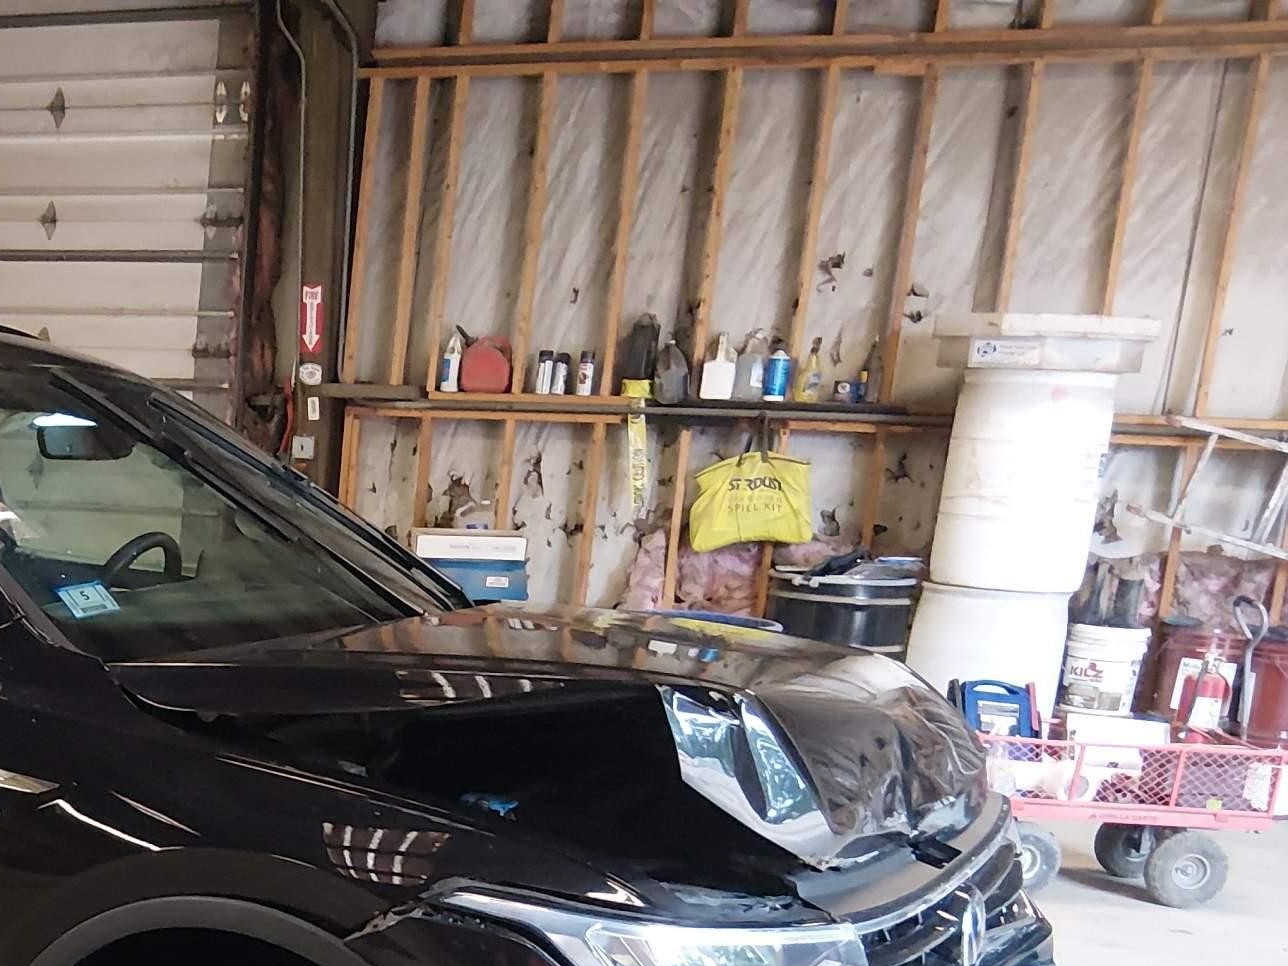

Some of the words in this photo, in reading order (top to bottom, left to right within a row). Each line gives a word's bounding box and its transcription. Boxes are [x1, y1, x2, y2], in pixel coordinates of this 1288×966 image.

[729, 477, 782, 491] STRDUST
[728, 503, 758, 513] SPILL
[765, 502, 782, 512] KIT
[79, 590, 90, 601] 5
[1070, 665, 1104, 679] KILZ
